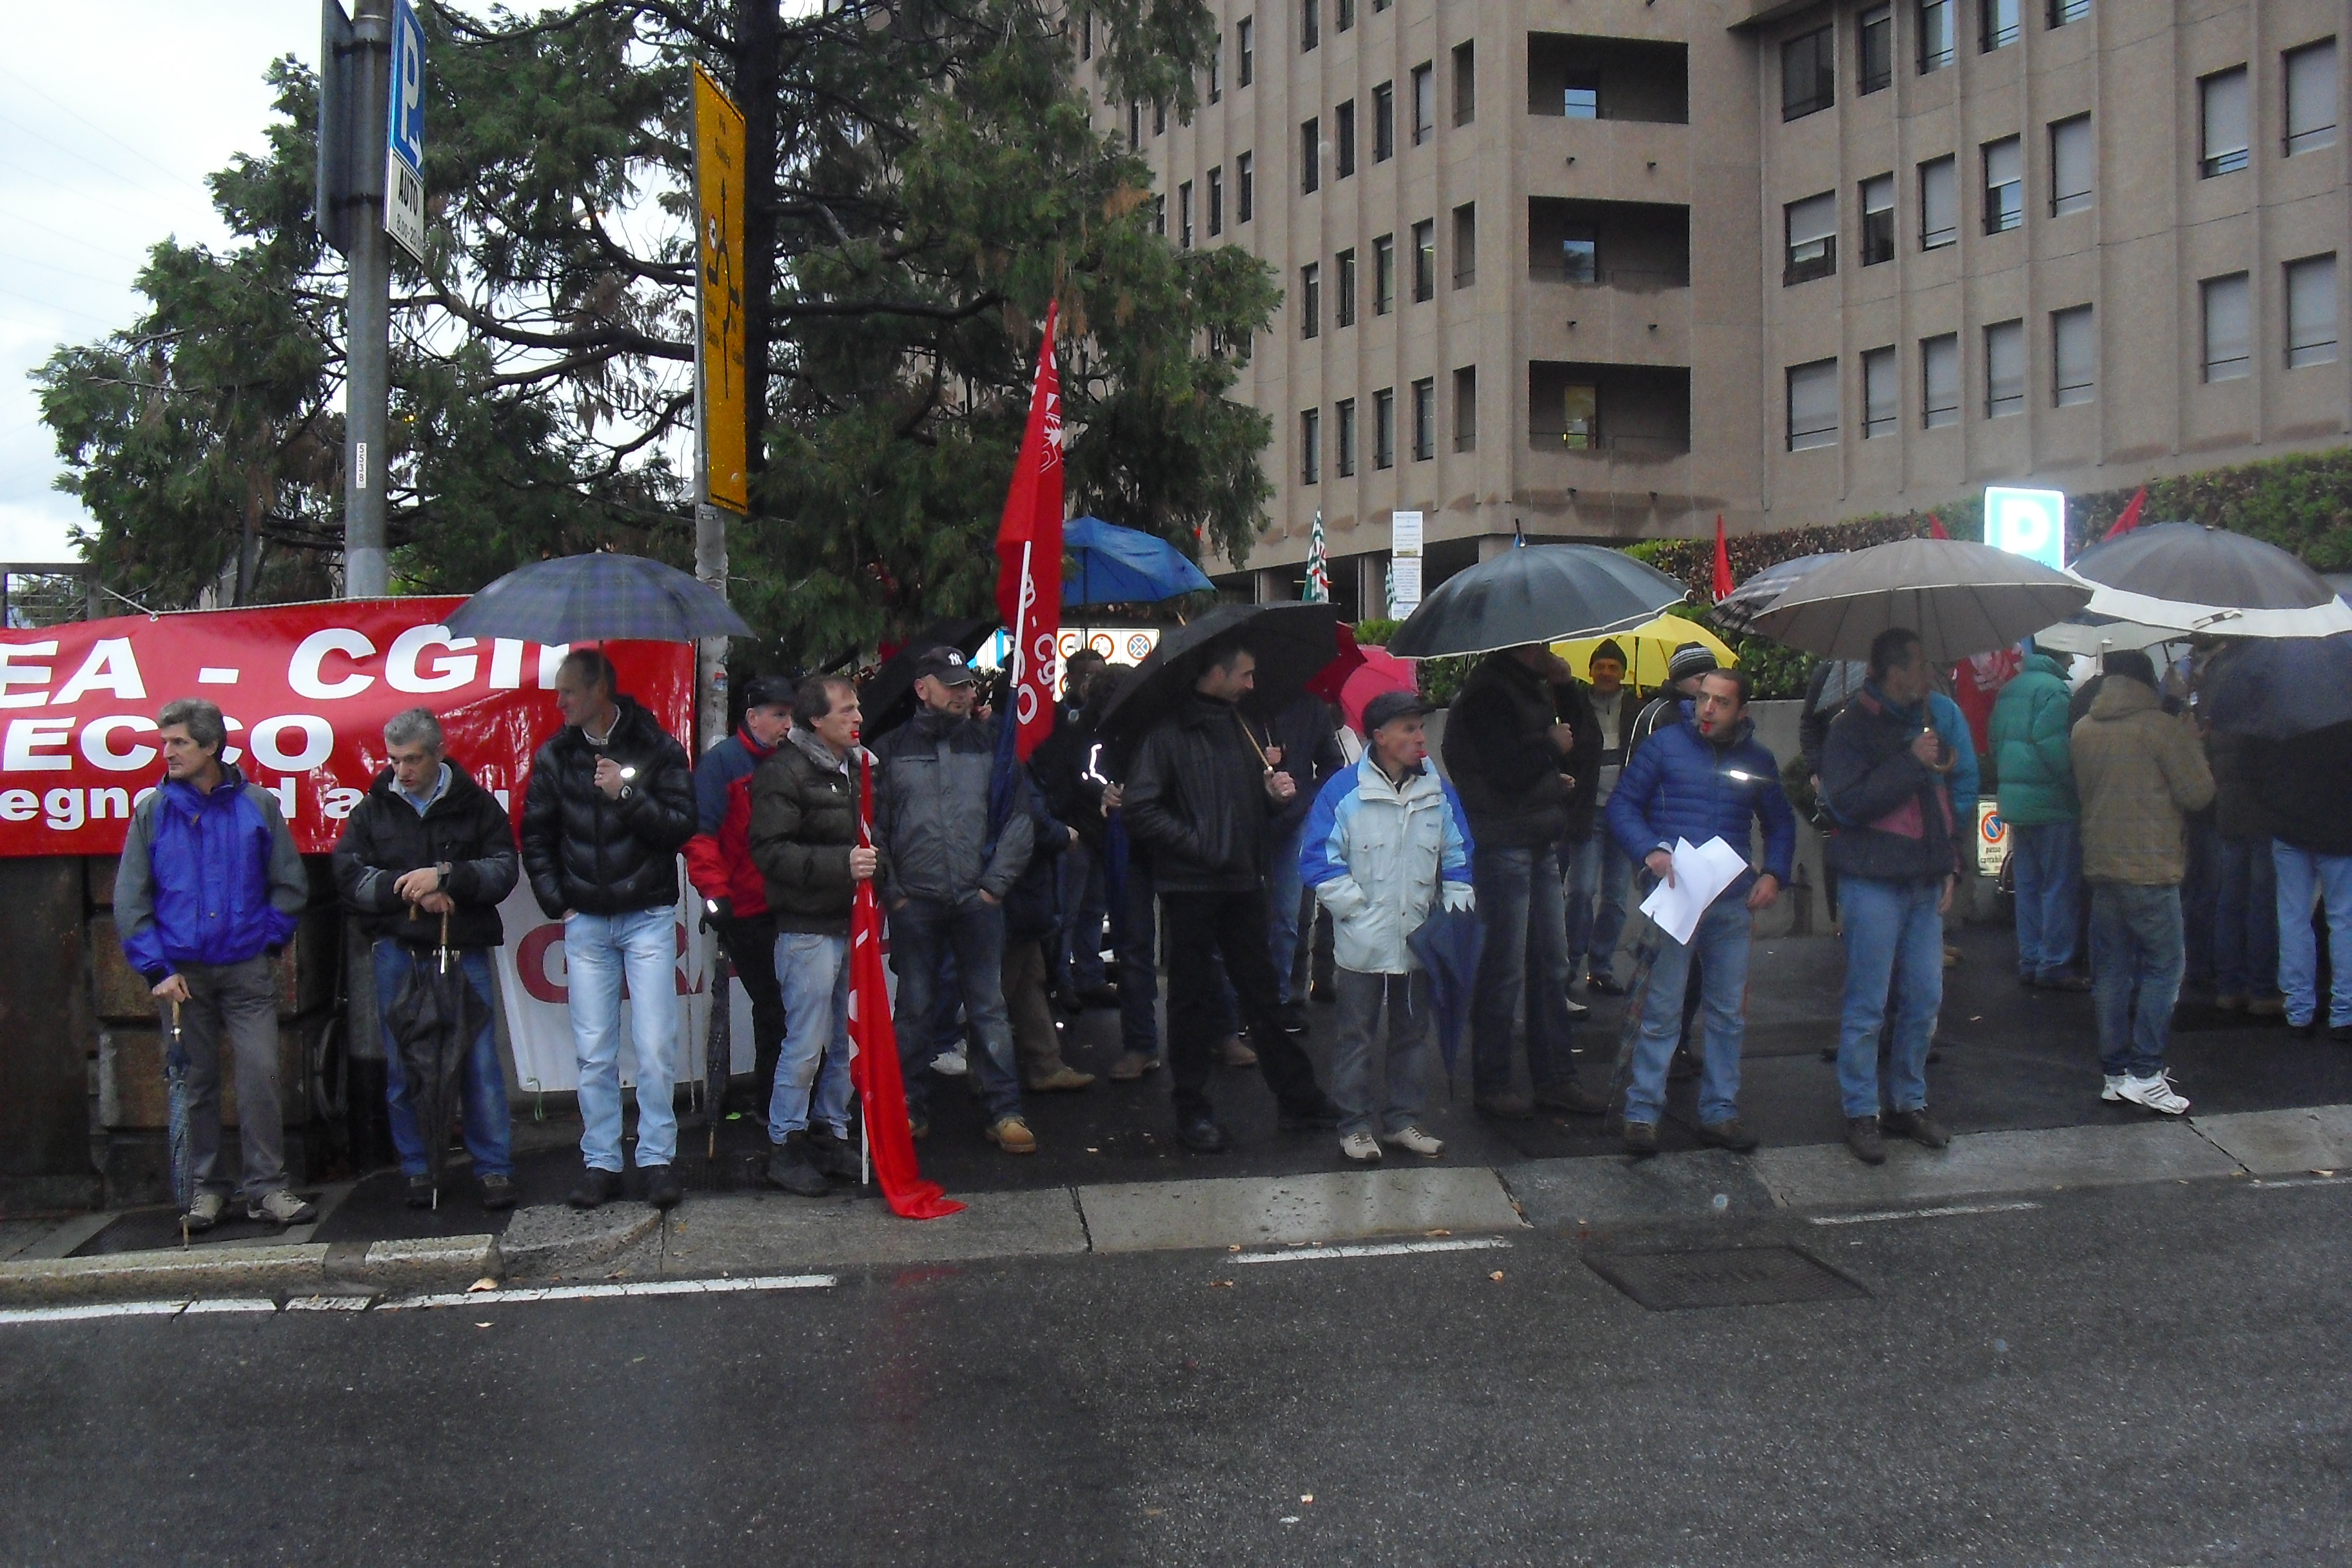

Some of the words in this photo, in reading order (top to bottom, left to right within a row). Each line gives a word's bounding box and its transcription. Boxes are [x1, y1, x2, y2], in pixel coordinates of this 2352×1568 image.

[401, 15, 419, 142] P
[398, 166, 418, 216] AUTO
[0, 636, 147, 709] EA
